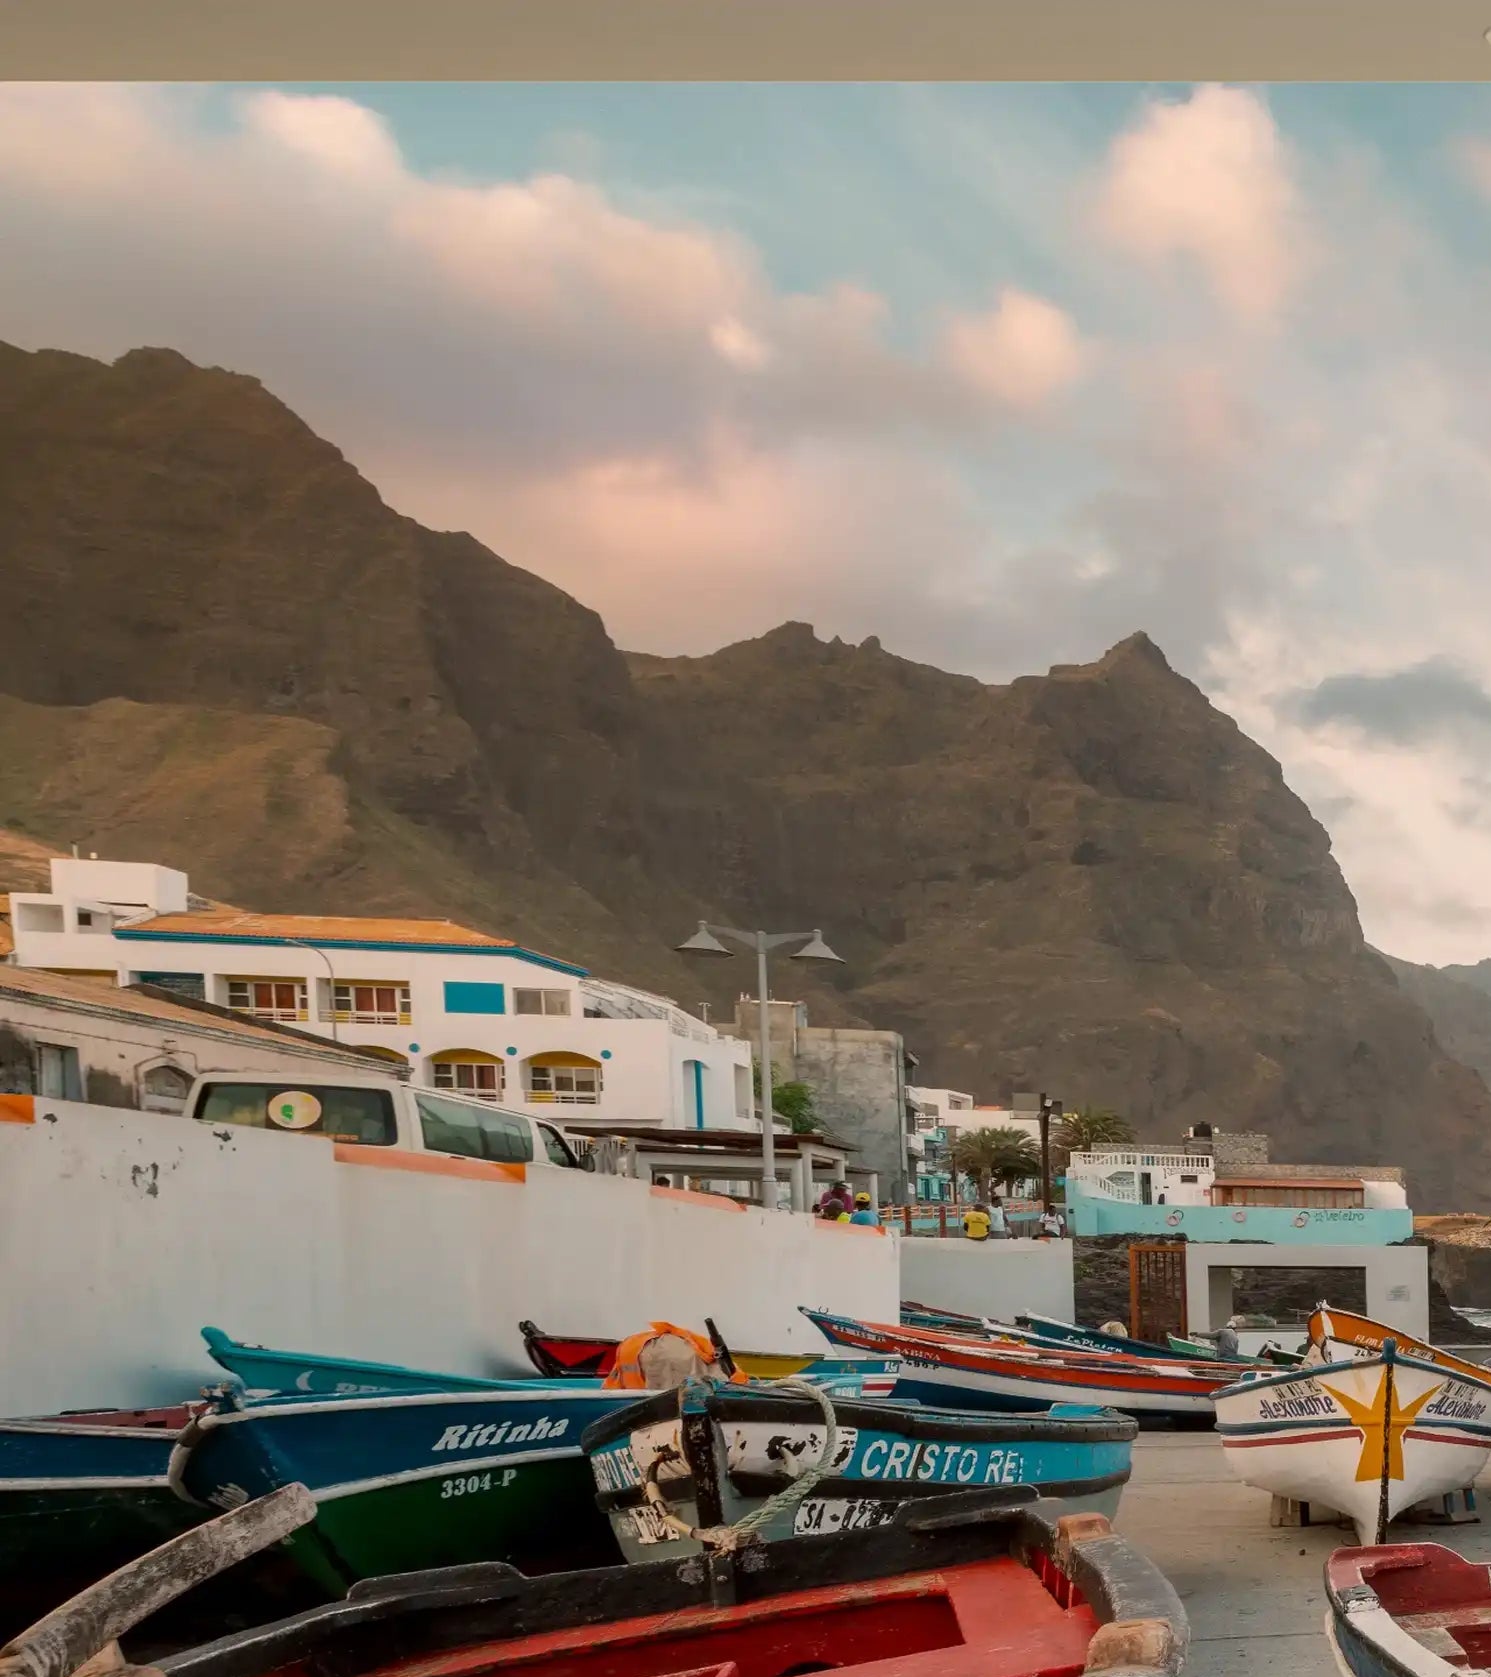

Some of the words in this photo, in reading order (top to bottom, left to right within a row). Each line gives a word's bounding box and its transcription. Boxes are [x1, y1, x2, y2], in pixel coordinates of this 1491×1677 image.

[432, 1416, 569, 1451] Ritinha
[861, 1440, 978, 1482] CRISTO
[441, 1469, 517, 1499] 3304-P
